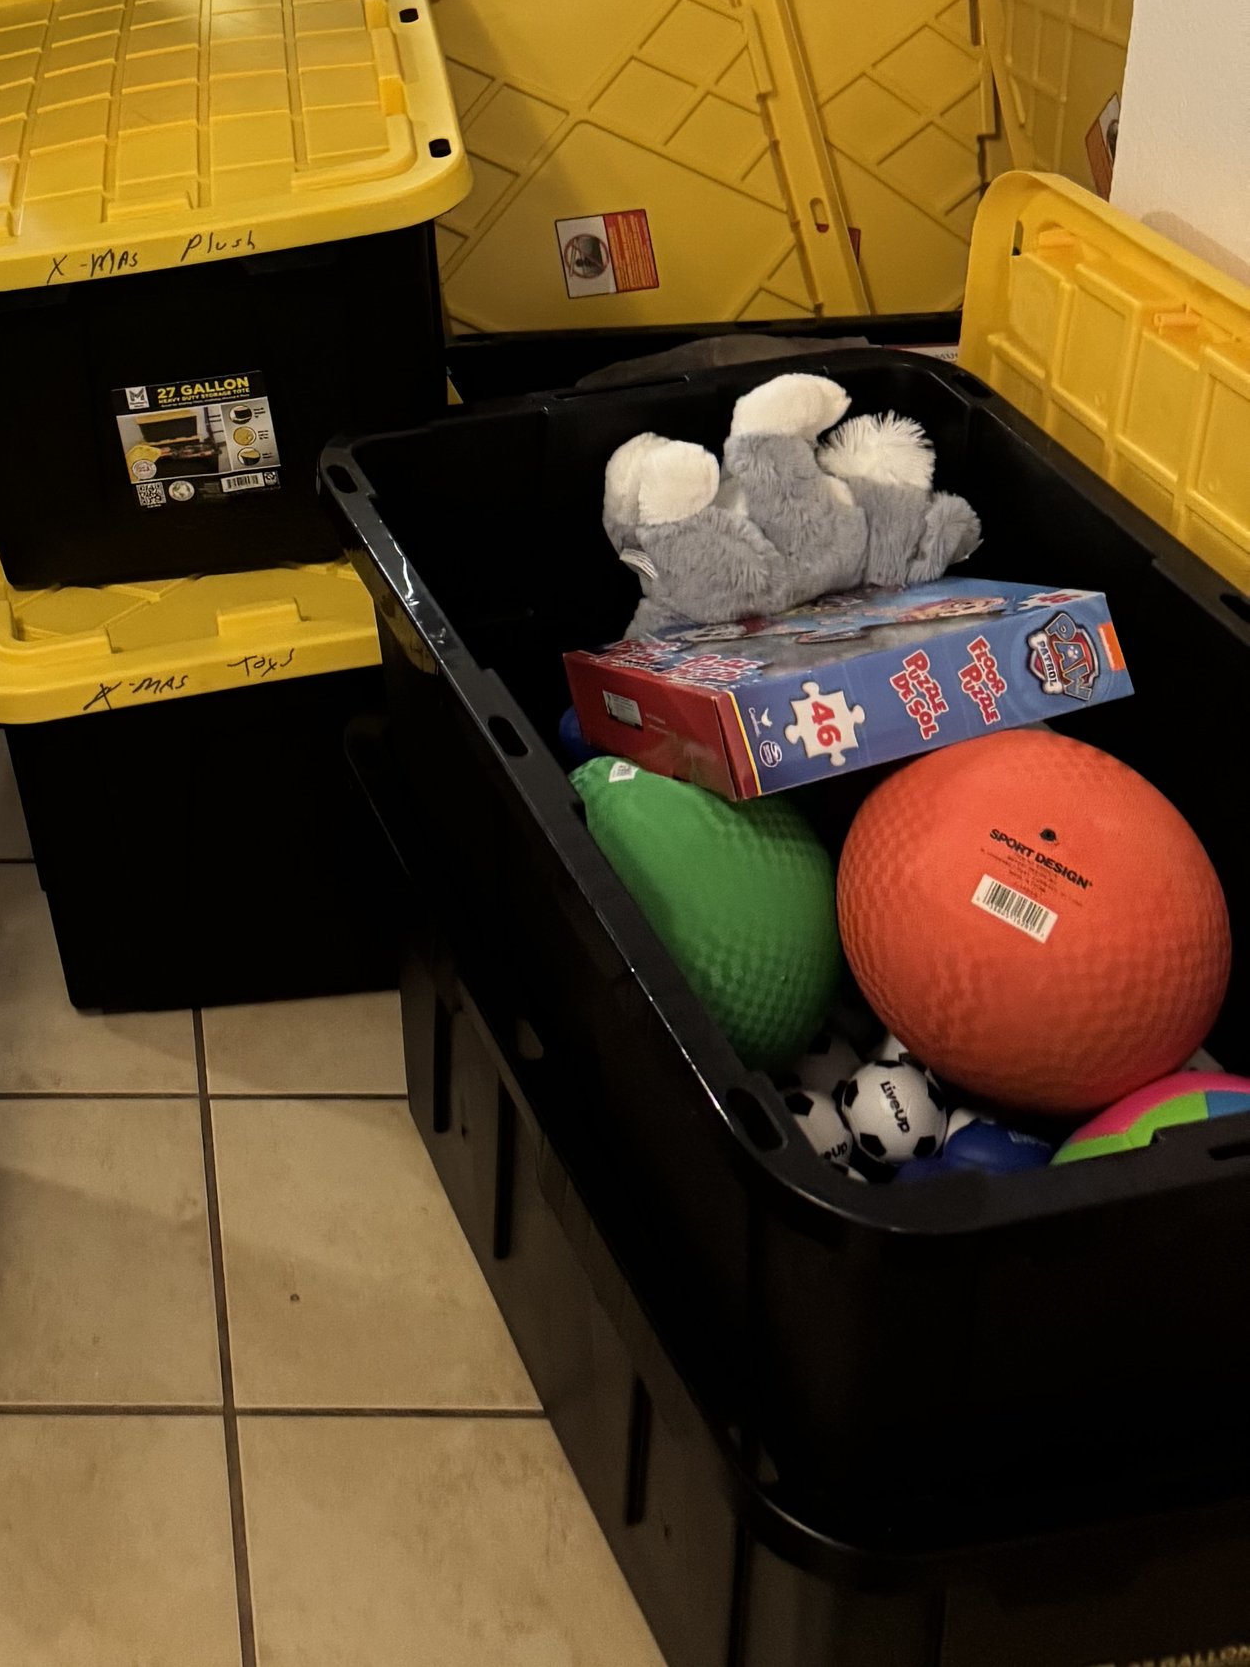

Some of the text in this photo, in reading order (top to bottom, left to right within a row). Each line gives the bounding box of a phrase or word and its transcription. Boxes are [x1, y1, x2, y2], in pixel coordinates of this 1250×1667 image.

[157, 376, 249, 399] 27 GALLON
[201, 390, 231, 399] STORAGE
[1037, 640, 1058, 687] PATROL
[1045, 612, 1094, 700] PAW
[810, 700, 842, 747] 46
[989, 828, 1035, 858] SPORT
[880, 1081, 910, 1134] LiveUp
